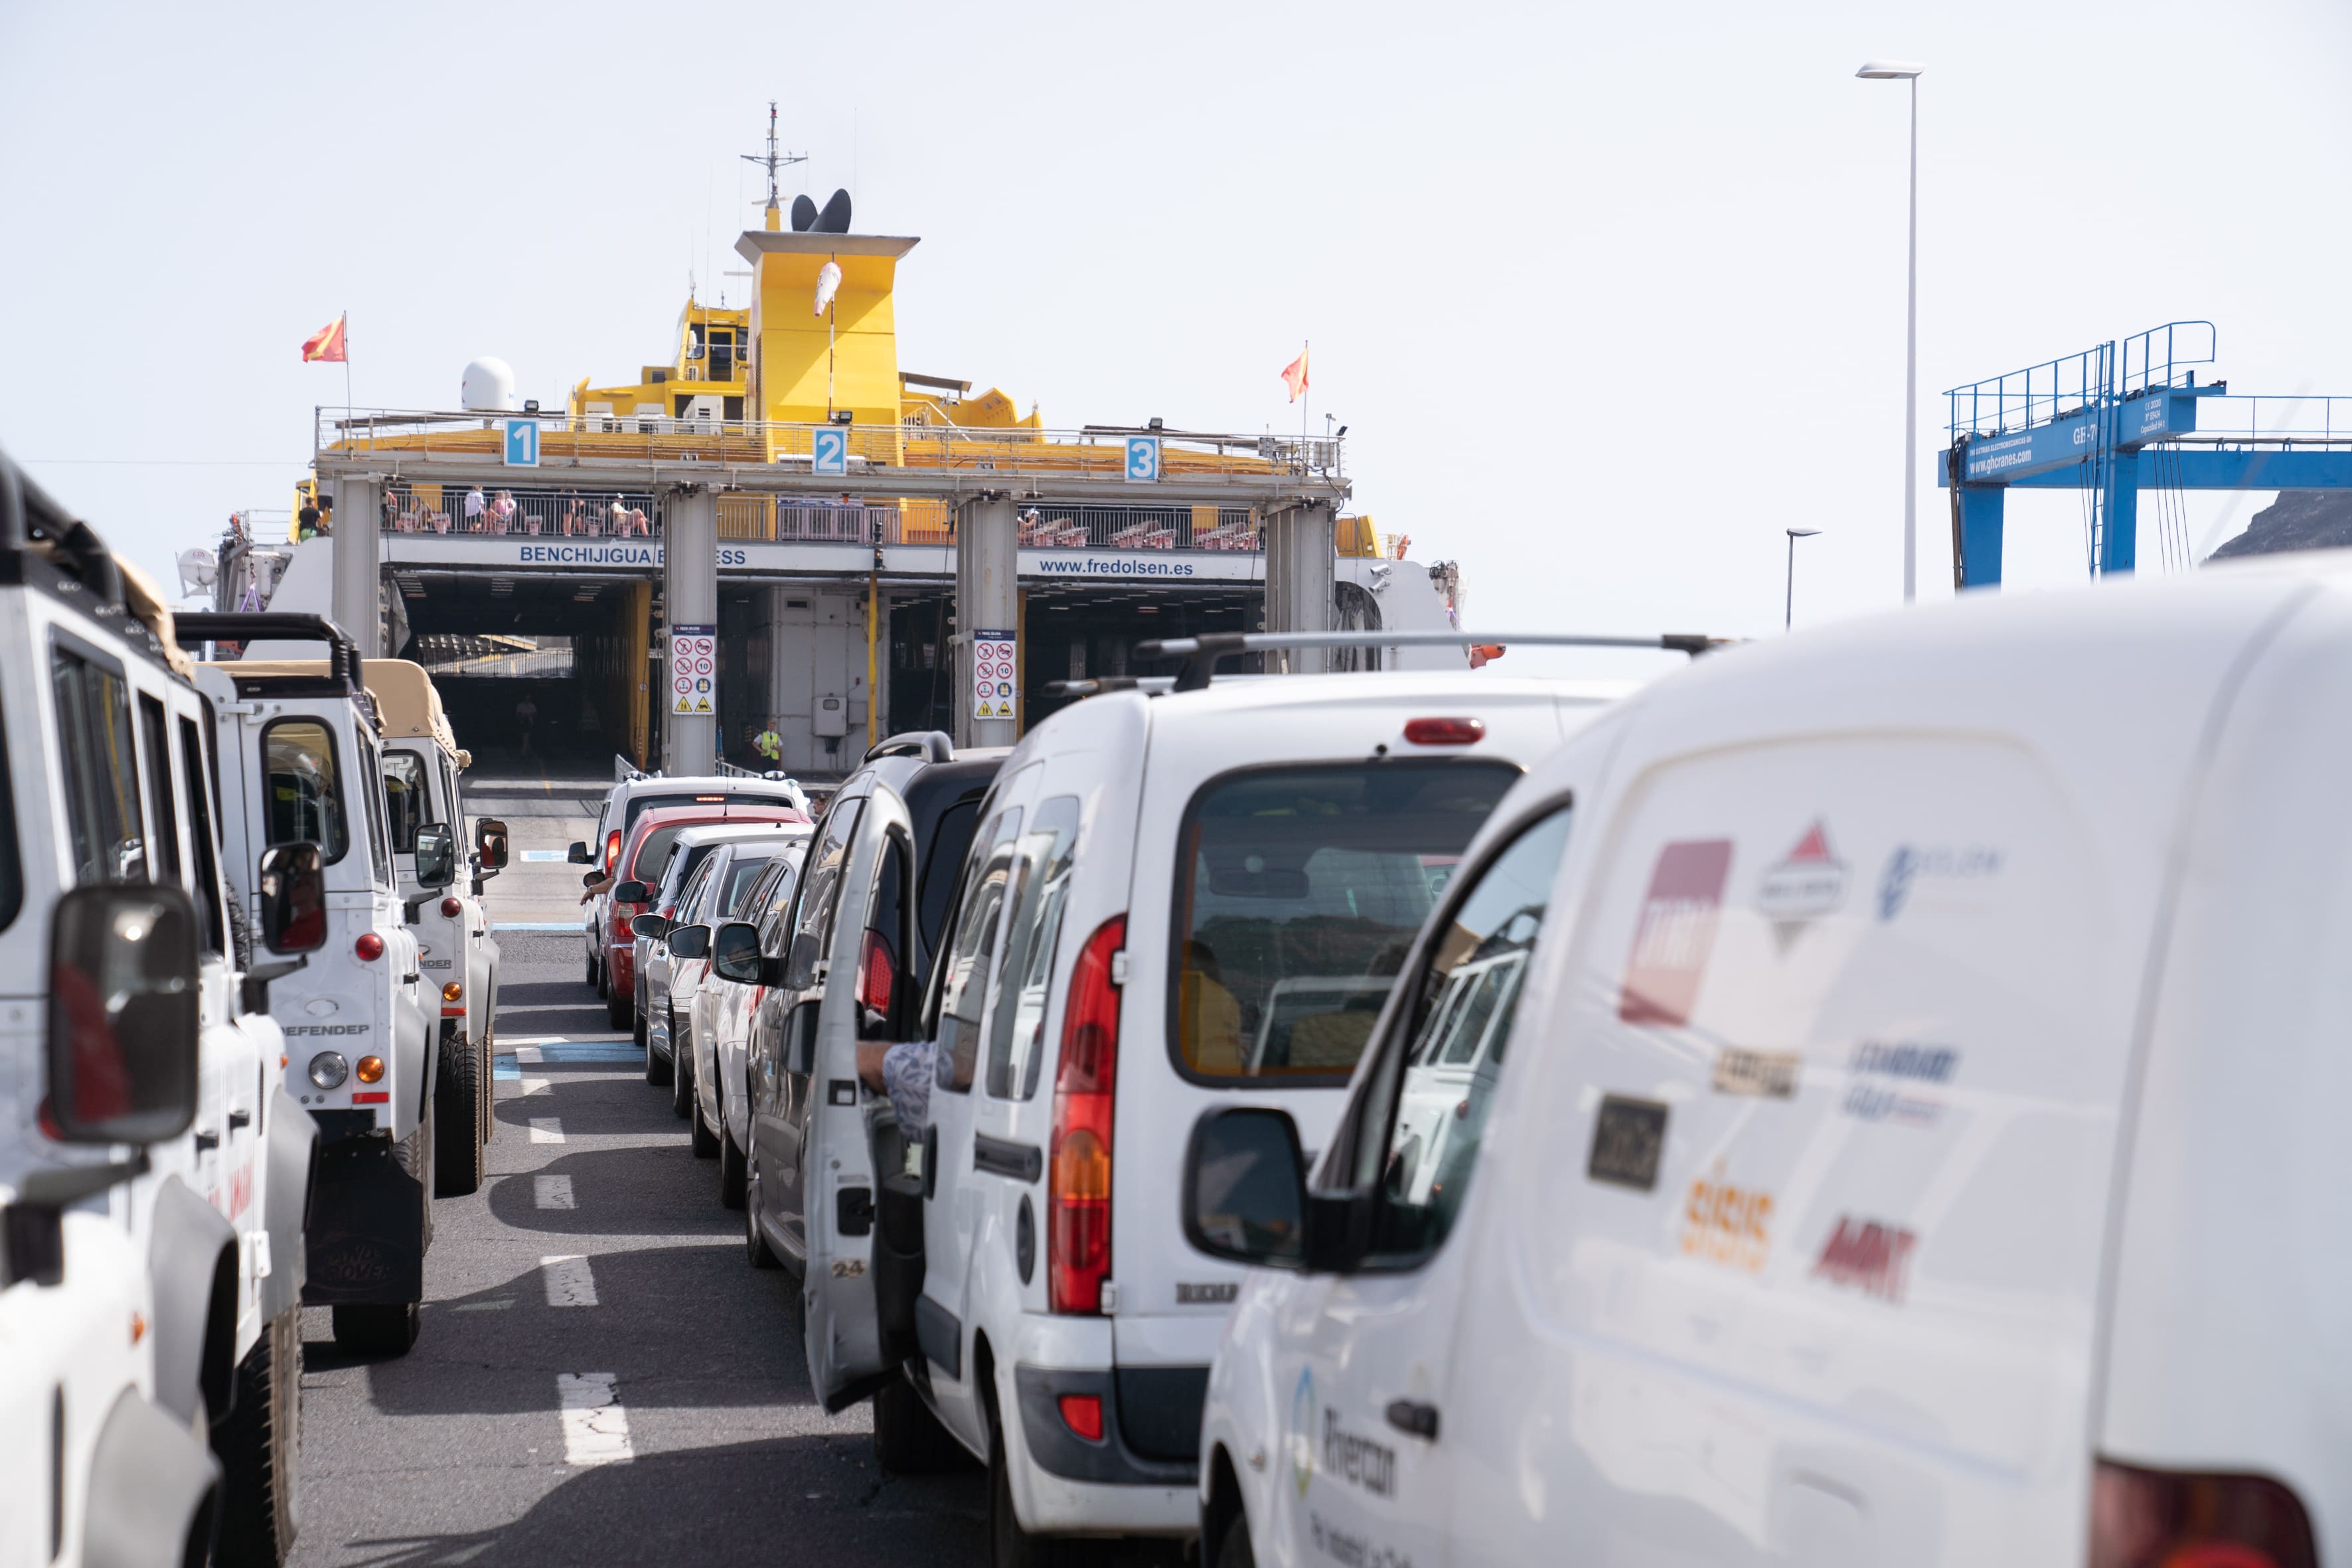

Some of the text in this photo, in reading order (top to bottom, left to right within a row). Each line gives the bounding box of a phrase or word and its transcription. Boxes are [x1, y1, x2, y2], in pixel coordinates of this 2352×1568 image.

[513, 425, 532, 461] 1
[818, 433, 841, 469] 2
[1131, 441, 1154, 477] 3
[1970, 449, 2032, 475] www.ghcranes.com
[520, 546, 651, 564] BENCHIJIGUA
[1040, 558, 1194, 575] www.fredolsen.es
